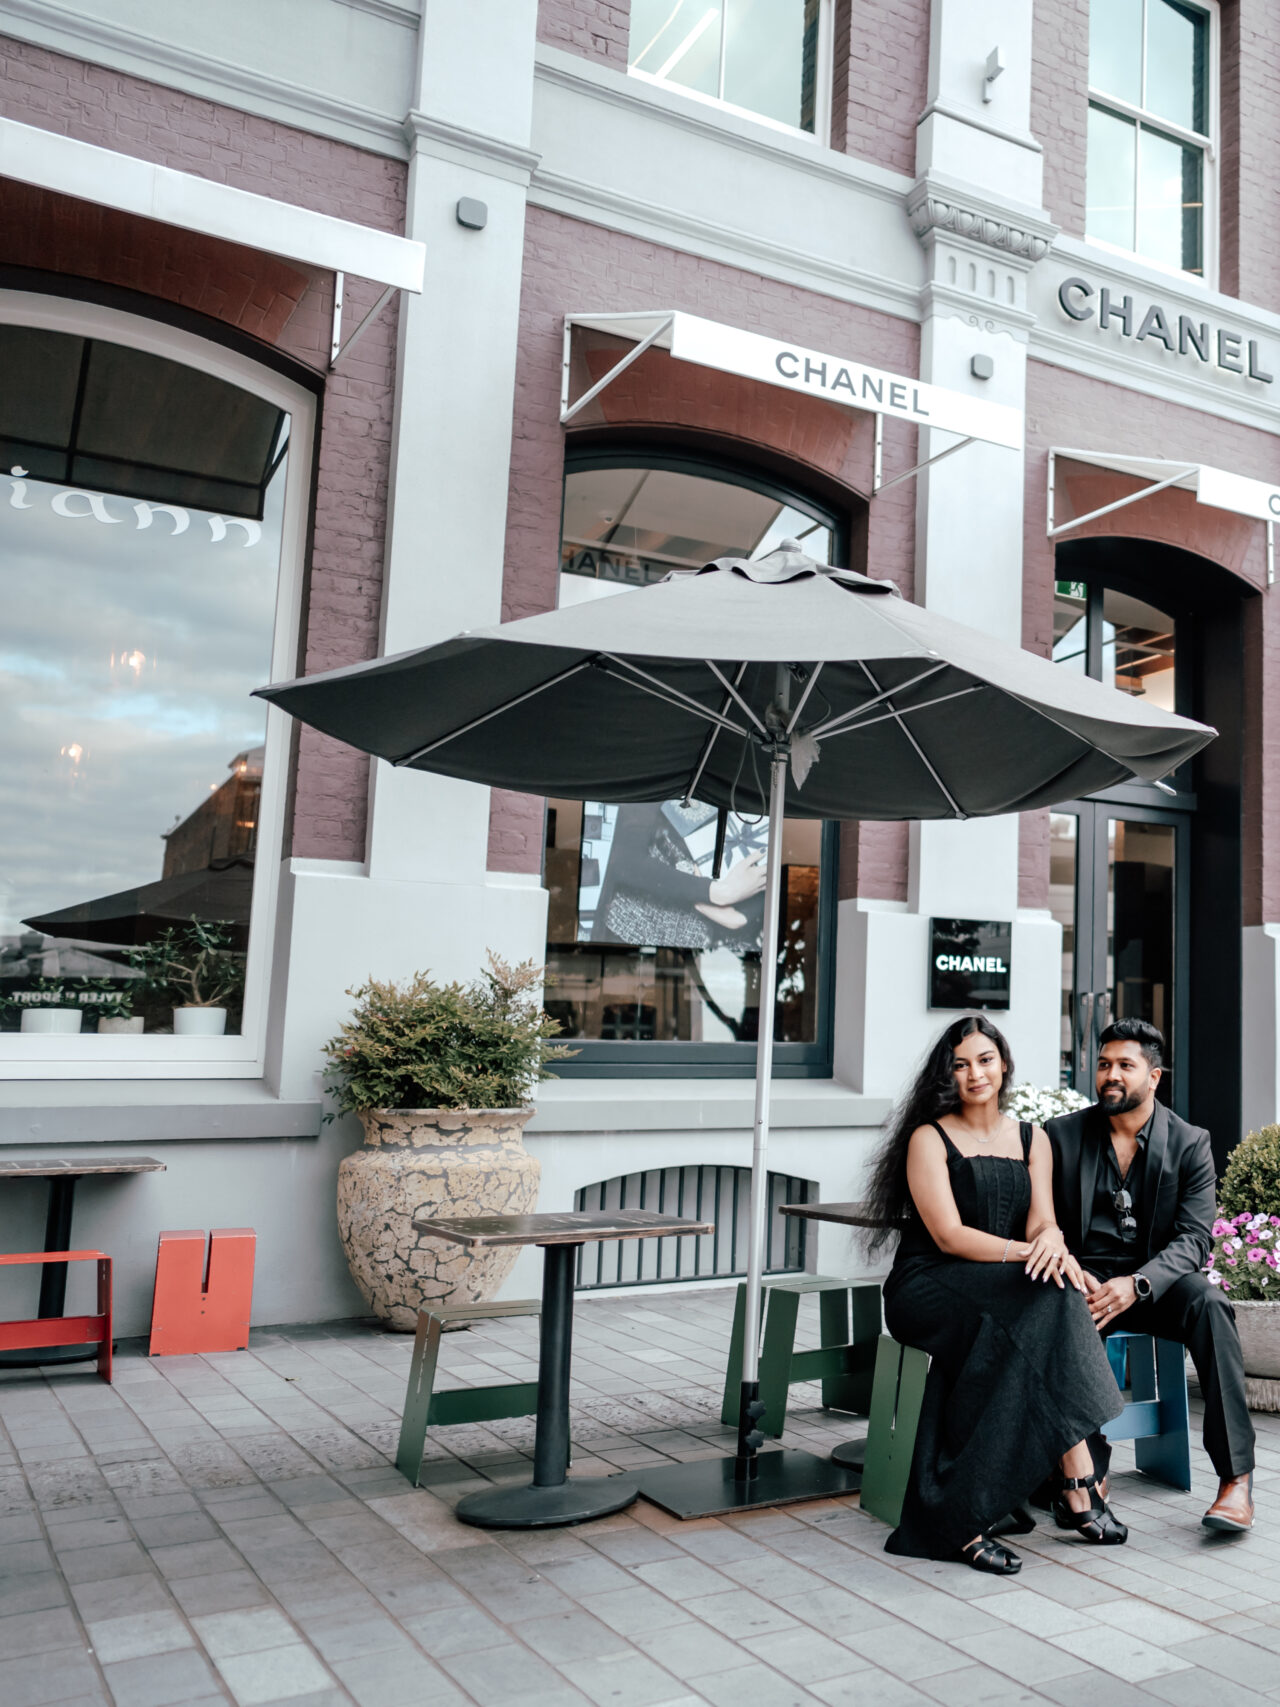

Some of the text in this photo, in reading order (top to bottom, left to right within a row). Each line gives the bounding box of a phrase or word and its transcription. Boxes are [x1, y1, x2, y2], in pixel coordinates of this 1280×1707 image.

[1058, 276, 1274, 384] CHANEL
[775, 351, 930, 417] CHANEL
[935, 954, 1008, 973] CHANEL
